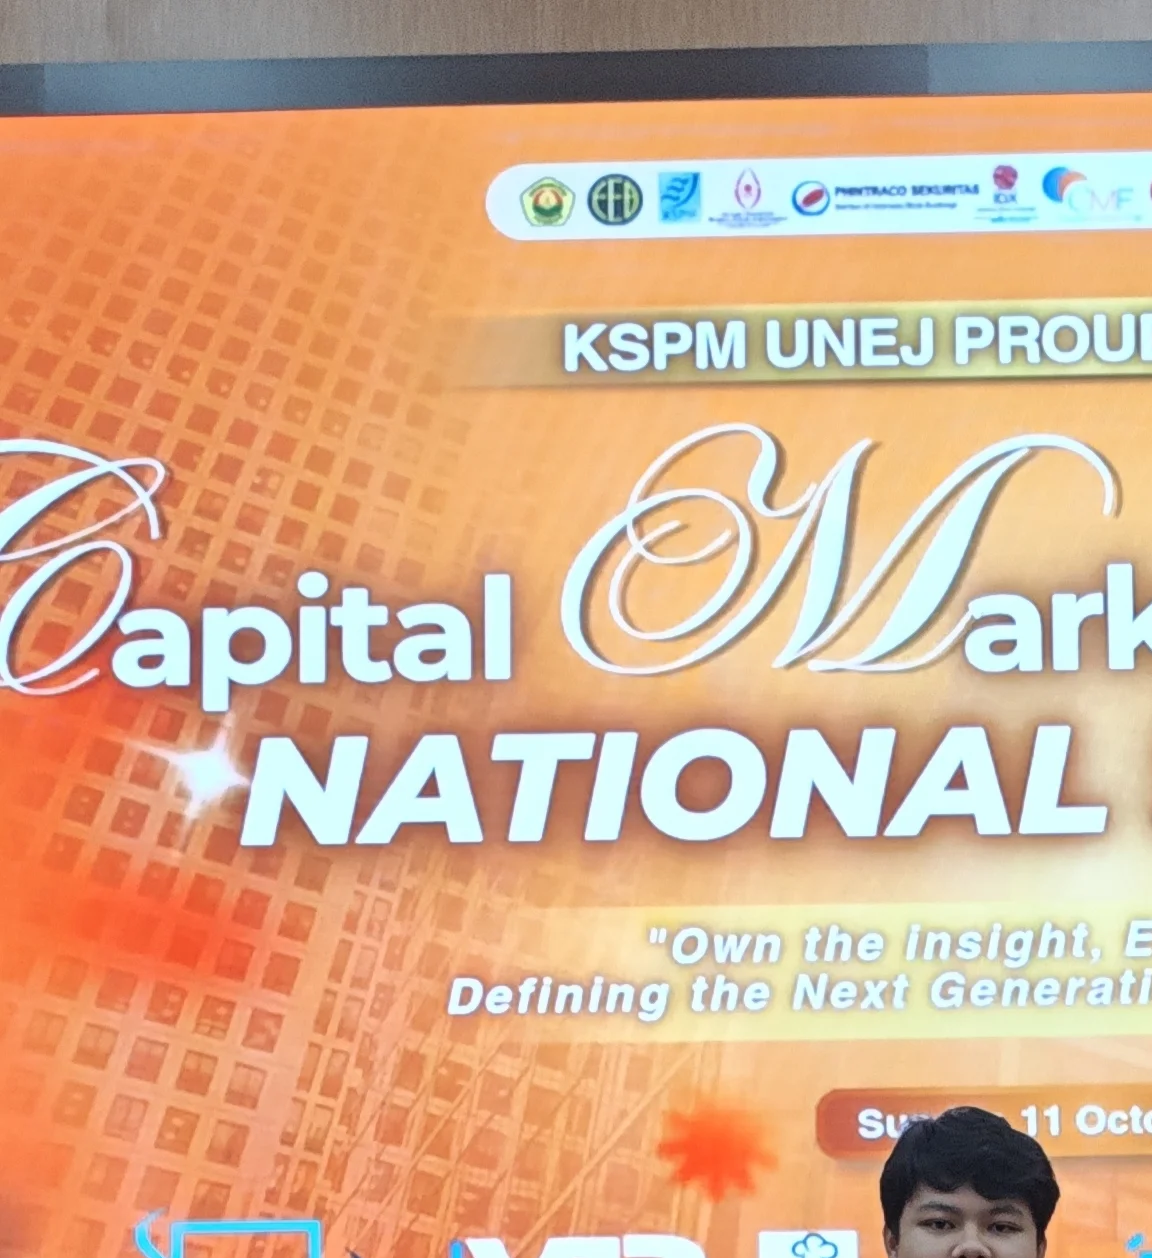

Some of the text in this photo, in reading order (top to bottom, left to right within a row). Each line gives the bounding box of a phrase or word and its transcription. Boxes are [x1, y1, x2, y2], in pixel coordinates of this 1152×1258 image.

[564, 320, 746, 372] KSPM
[766, 317, 934, 368] UNEJ
[0, 438, 512, 712] Capital
[240, 725, 1108, 846] NATIONAL
[648, 927, 781, 965] "Own
[804, 925, 884, 963] the
[904, 921, 1102, 969] insight,
[447, 976, 669, 1022] Defining
[691, 975, 770, 1012] the
[793, 973, 910, 1010] Next
[1021, 1104, 1060, 1137] 11
